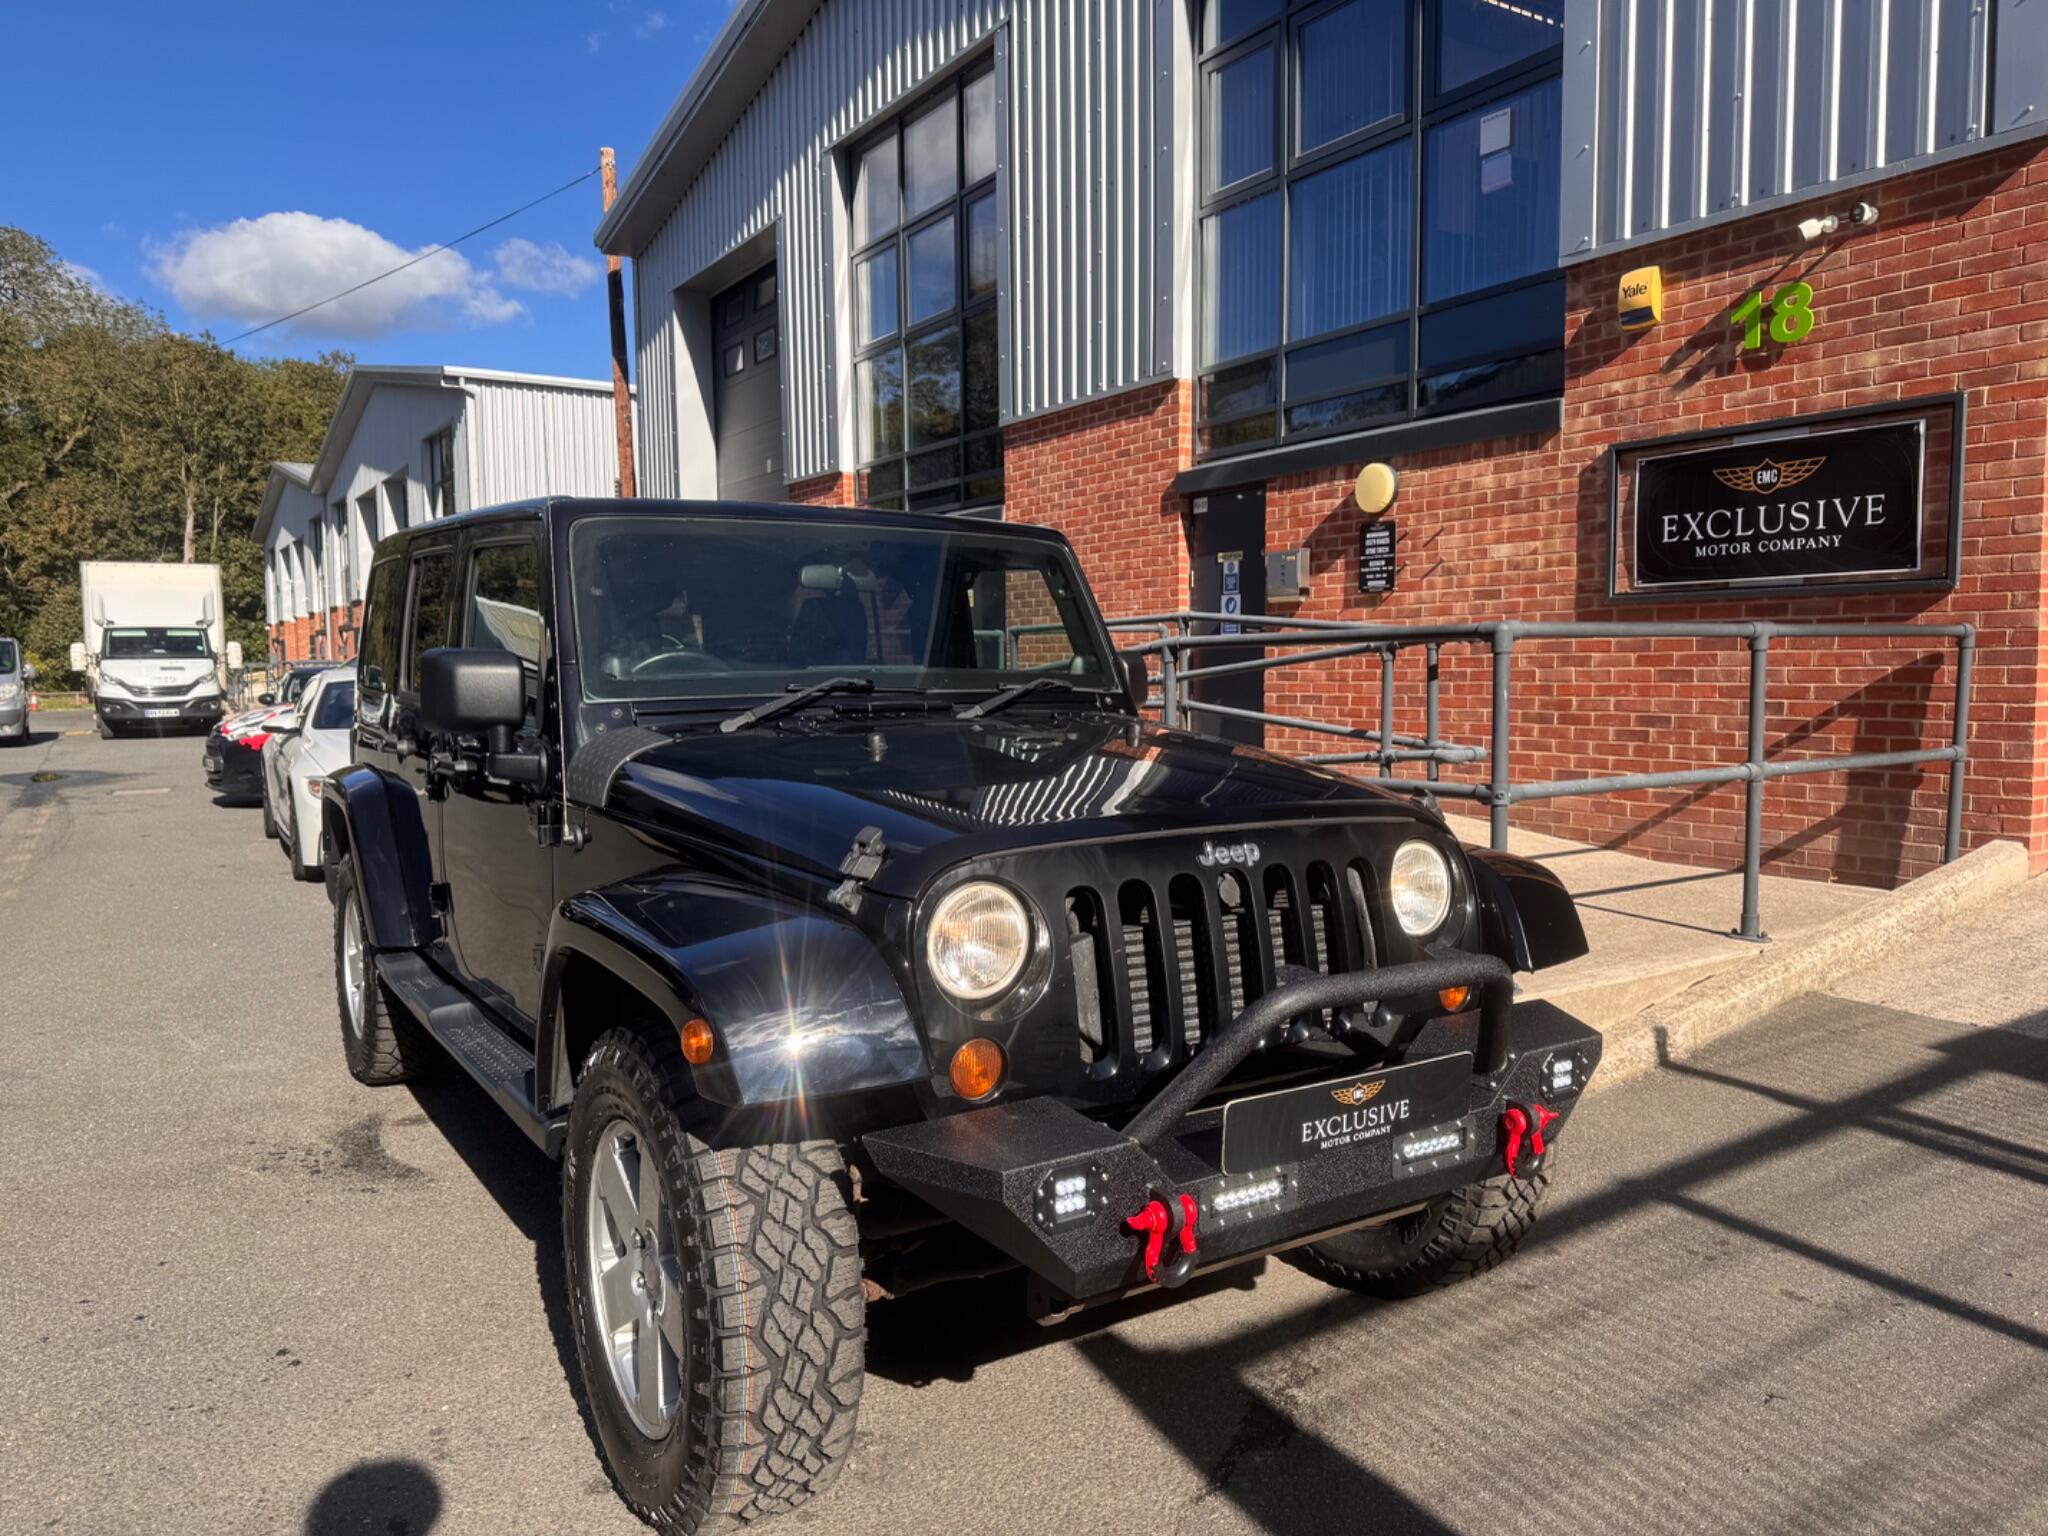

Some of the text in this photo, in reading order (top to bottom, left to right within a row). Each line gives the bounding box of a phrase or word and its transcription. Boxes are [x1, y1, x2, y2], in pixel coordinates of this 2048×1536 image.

[1622, 282, 1648, 300] Yale
[1730, 282, 1814, 350] 18
[1756, 469, 1778, 486] EMC
[1661, 493, 1887, 544] EXCLUSIVE
[1695, 534, 1843, 558] MOTOR COMPANY
[1196, 840, 1260, 867] Jeep
[1301, 1099, 1411, 1143] EXCLUSIVE
[1320, 1125, 1392, 1150] MOTOR COMPANY
